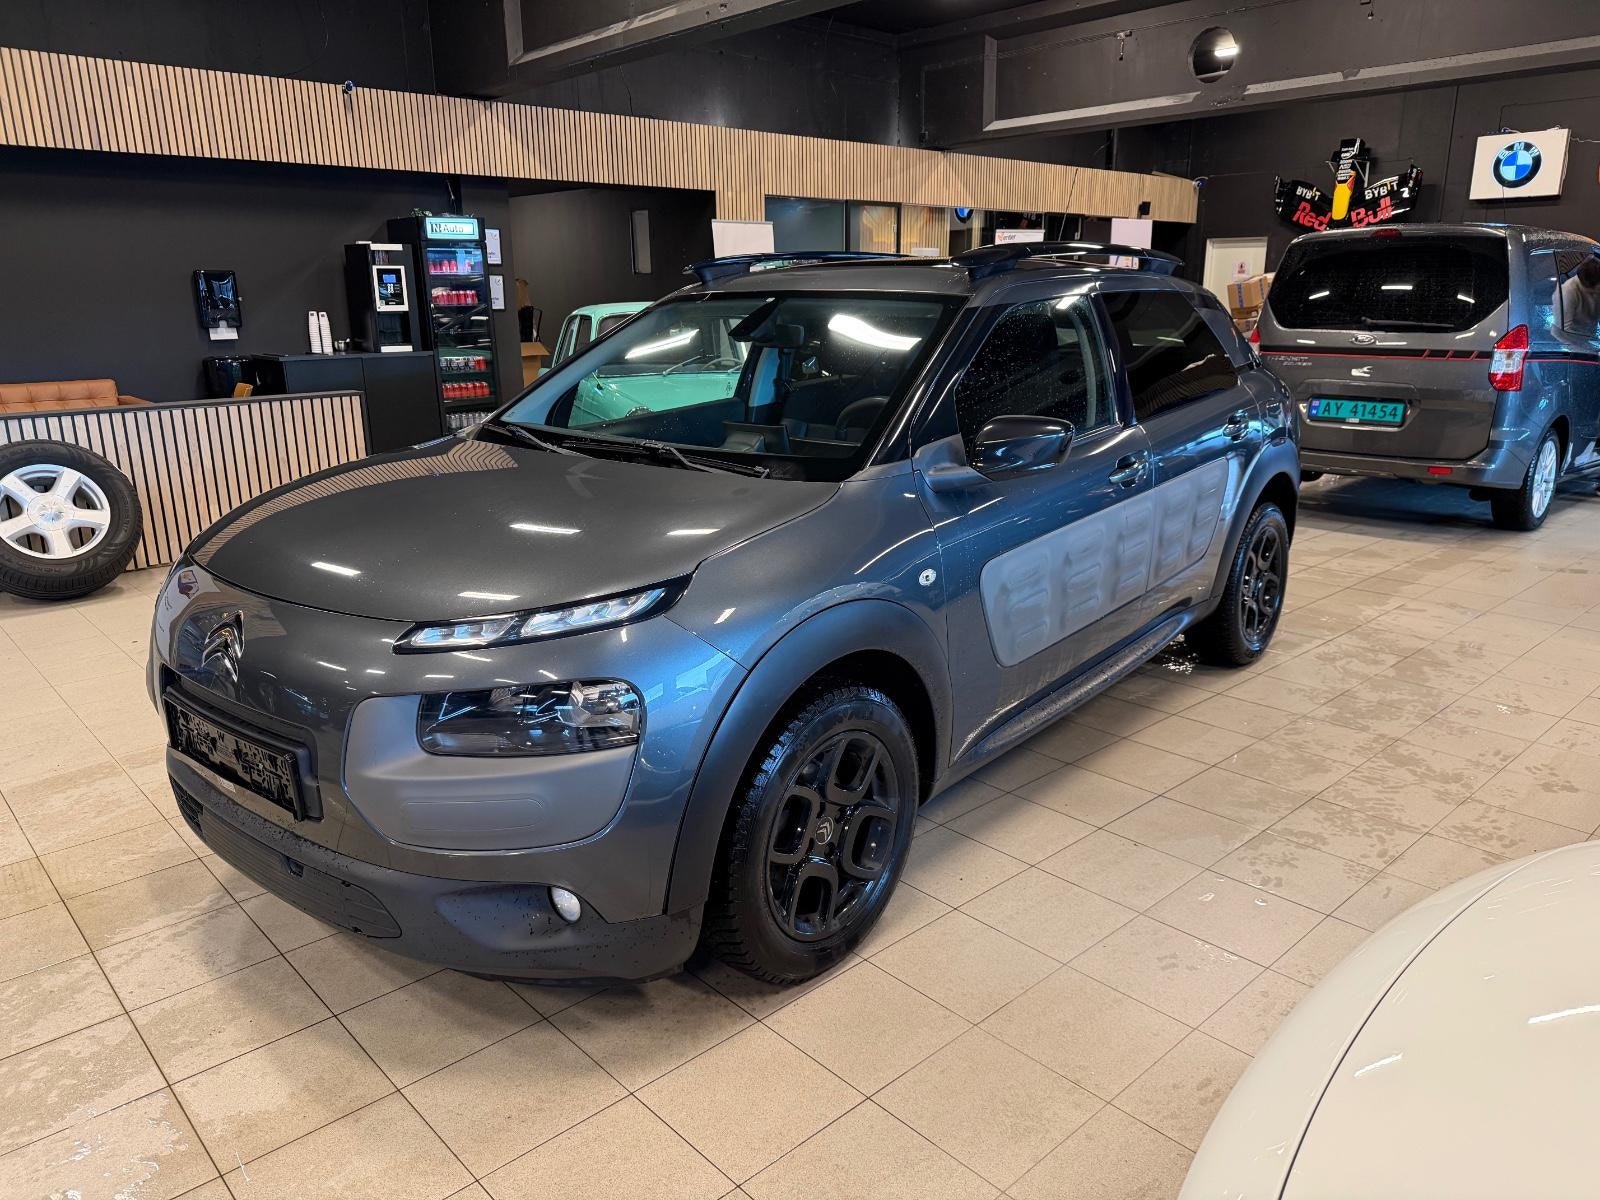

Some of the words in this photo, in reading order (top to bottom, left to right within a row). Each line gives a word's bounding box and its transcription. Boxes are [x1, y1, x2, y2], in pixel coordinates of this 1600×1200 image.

[1292, 201, 1331, 231] Red
[1351, 196, 1394, 228] Bull
[1322, 402, 1344, 416] AY
[1350, 403, 1398, 419] 41454
